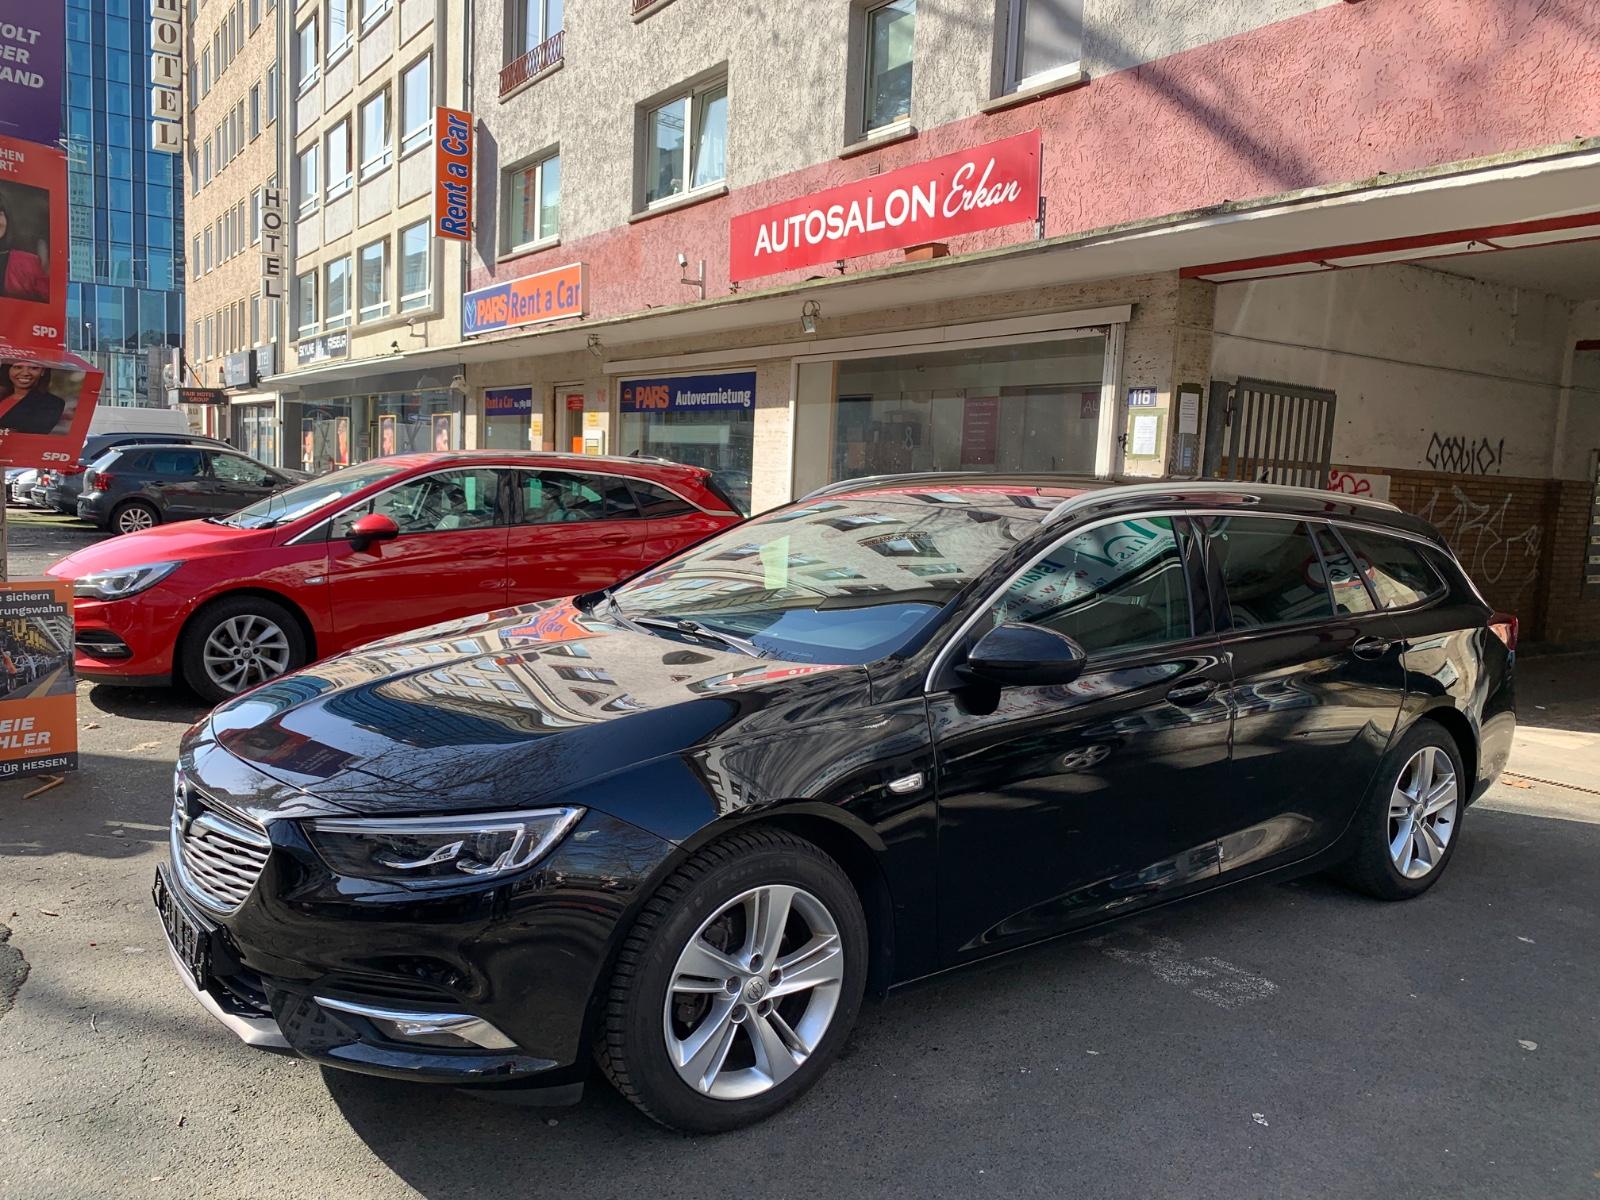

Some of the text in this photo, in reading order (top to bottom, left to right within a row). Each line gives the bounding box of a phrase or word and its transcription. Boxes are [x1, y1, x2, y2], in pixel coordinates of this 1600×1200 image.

[0, 22, 41, 45] OLT
[0, 44, 30, 65] ER
[0, 65, 44, 88] AND
[441, 114, 469, 236] Rent a Car
[754, 157, 1021, 256] AUTOSALON Erkan
[264, 188, 281, 298] HOTEL
[476, 280, 581, 326] PARS Rent a Car
[32, 324, 57, 338] SPD
[635, 385, 751, 409] PARS Autovermietung
[41, 451, 71, 462] SPD
[6, 592, 50, 602] sichern
[22, 757, 68, 771] HESSEN
